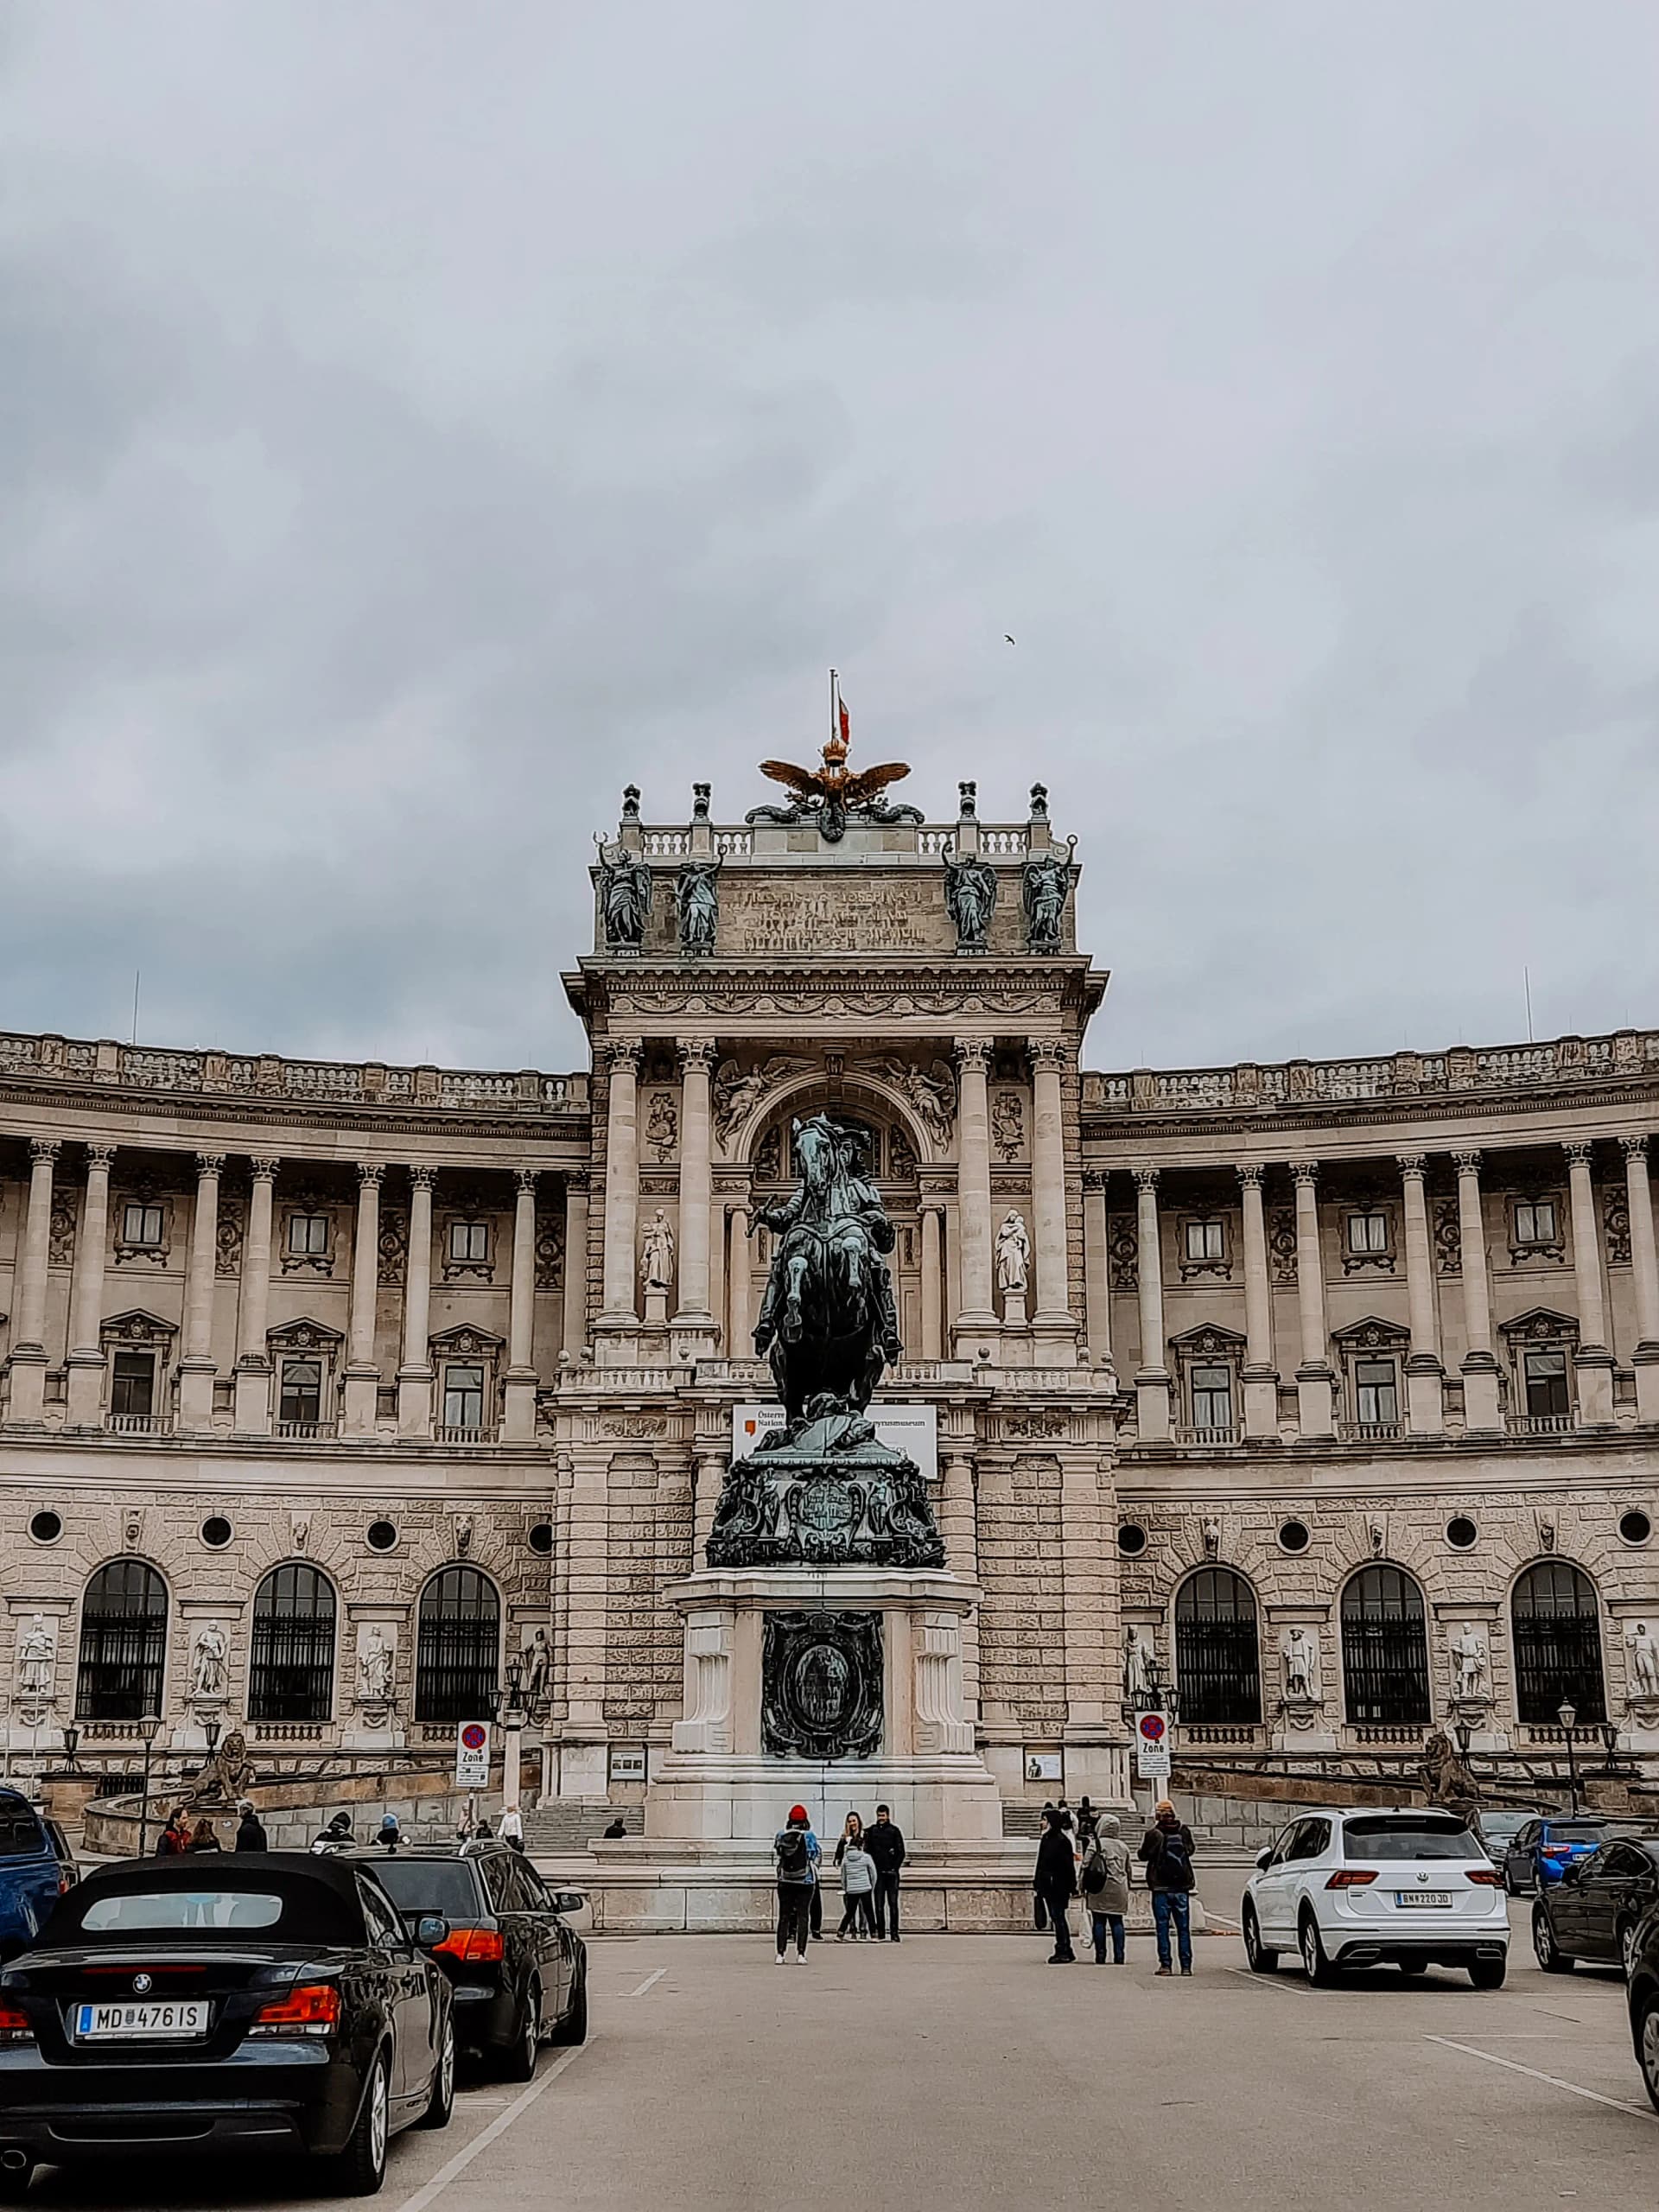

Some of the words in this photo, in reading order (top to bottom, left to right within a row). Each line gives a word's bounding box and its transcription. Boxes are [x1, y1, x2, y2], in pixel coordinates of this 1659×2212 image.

[1142, 1742, 1165, 1753] Zone
[462, 1751, 484, 1763] Zone
[96, 2008, 123, 2029] MD
